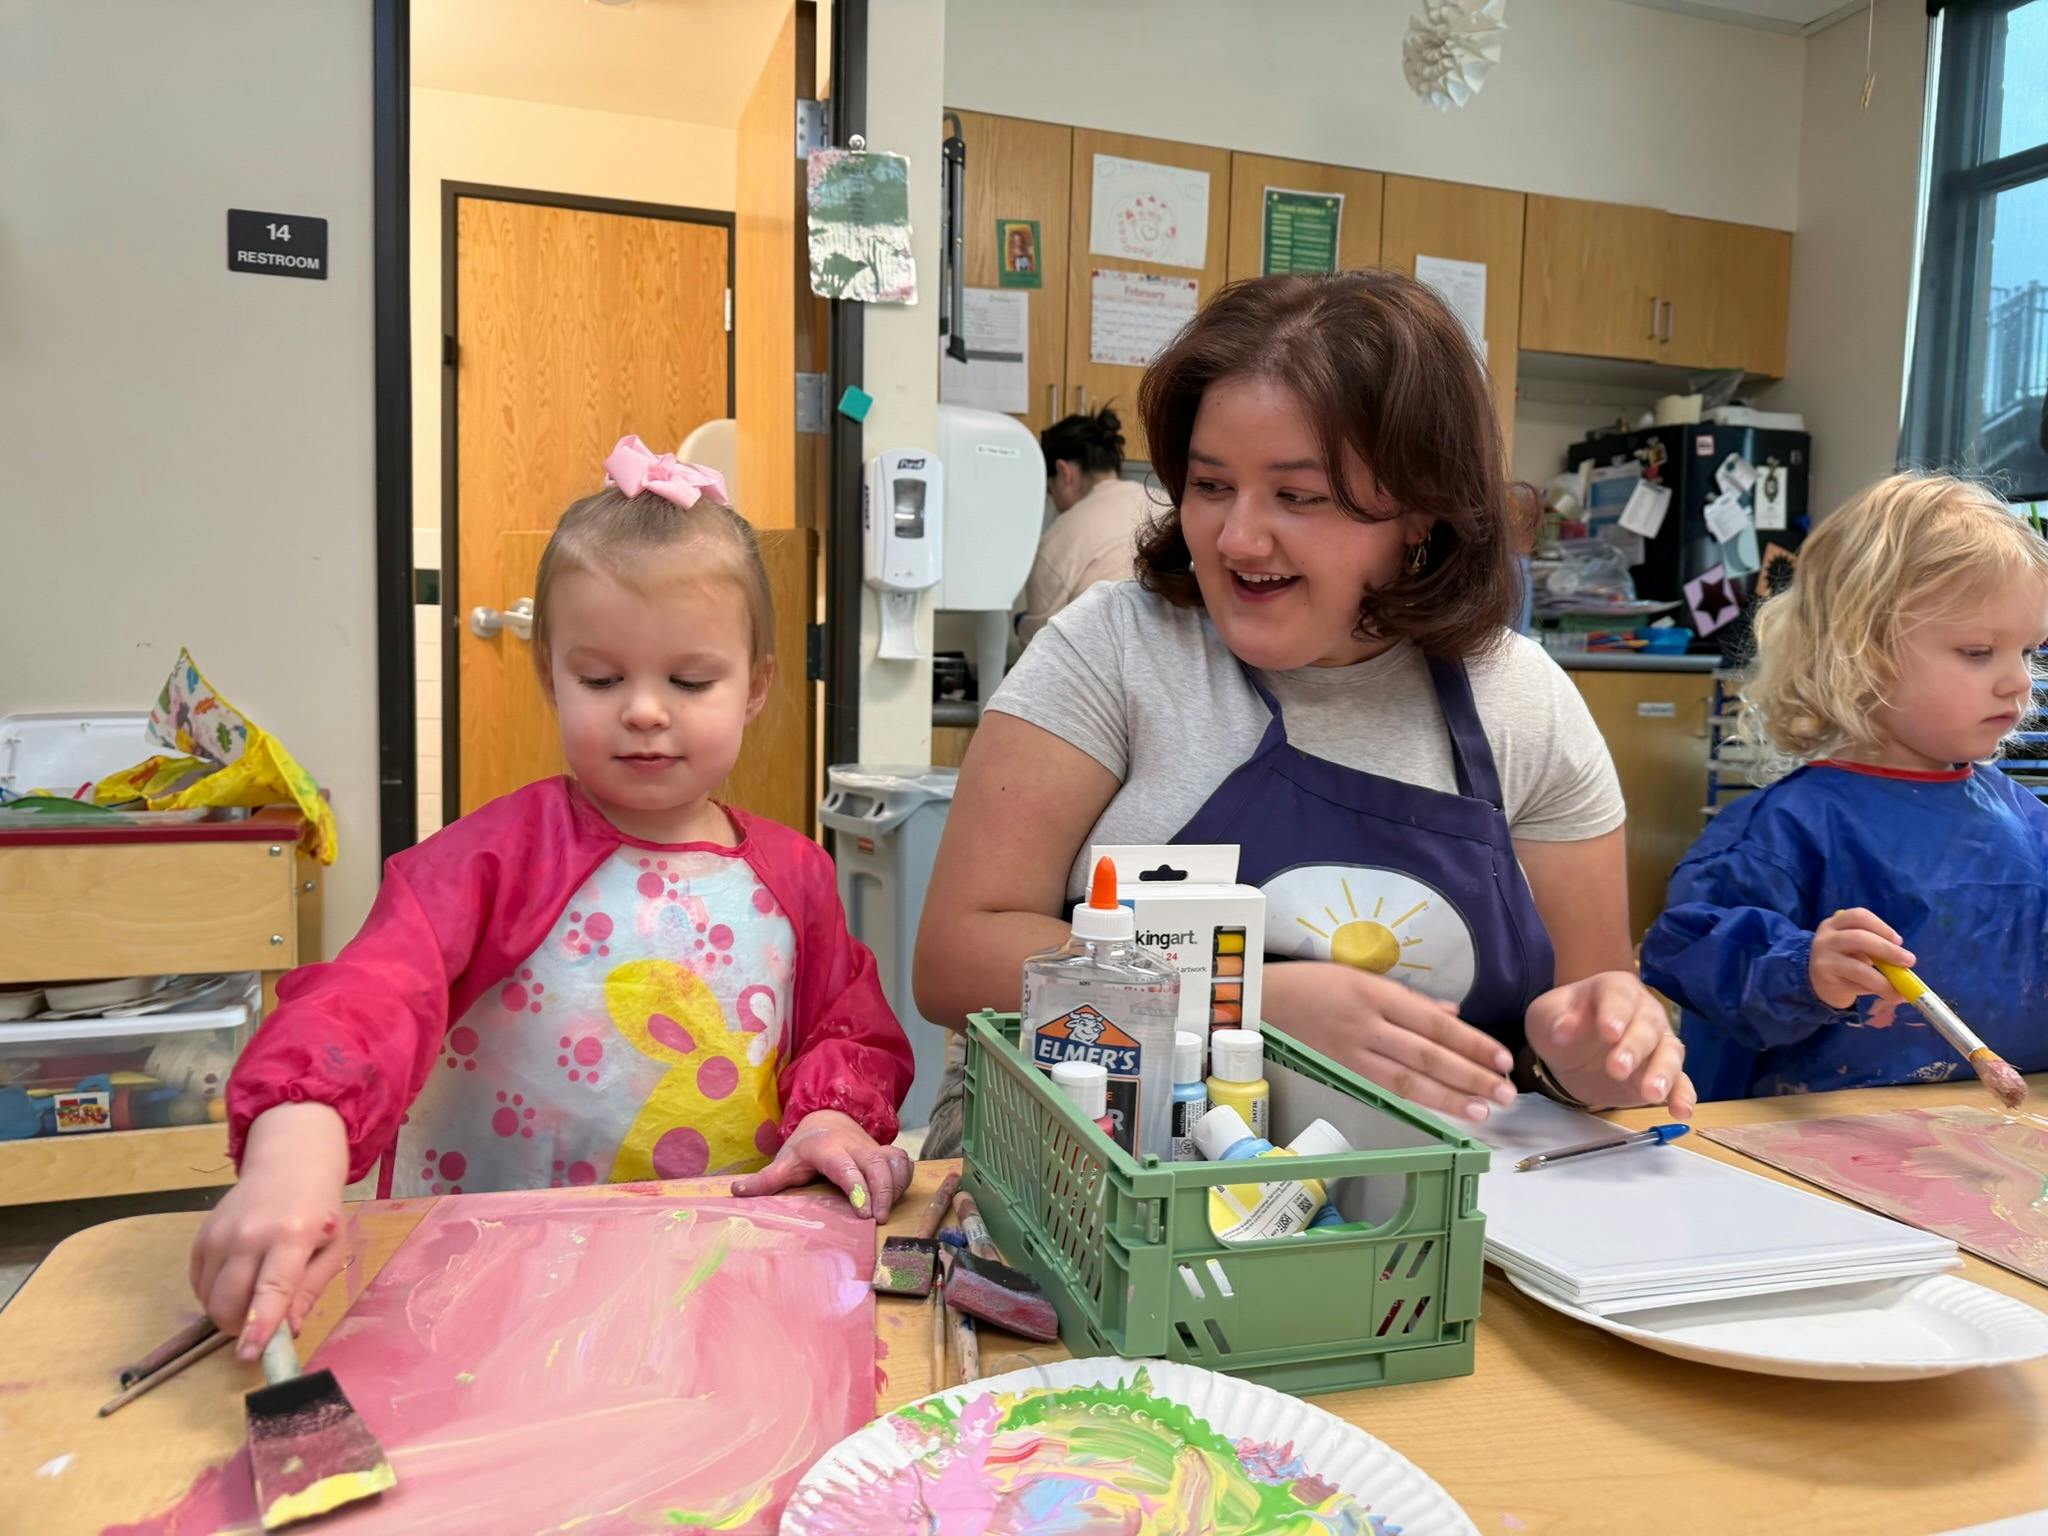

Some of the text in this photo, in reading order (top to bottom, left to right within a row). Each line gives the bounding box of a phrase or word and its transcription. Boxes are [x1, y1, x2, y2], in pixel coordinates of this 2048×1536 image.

[265, 223, 291, 242] 14
[237, 250, 320, 270] RESTROOM
[1124, 285, 1165, 300] February
[1166, 952, 1178, 961] 24
[1038, 1039, 1136, 1071] ELMER'S
